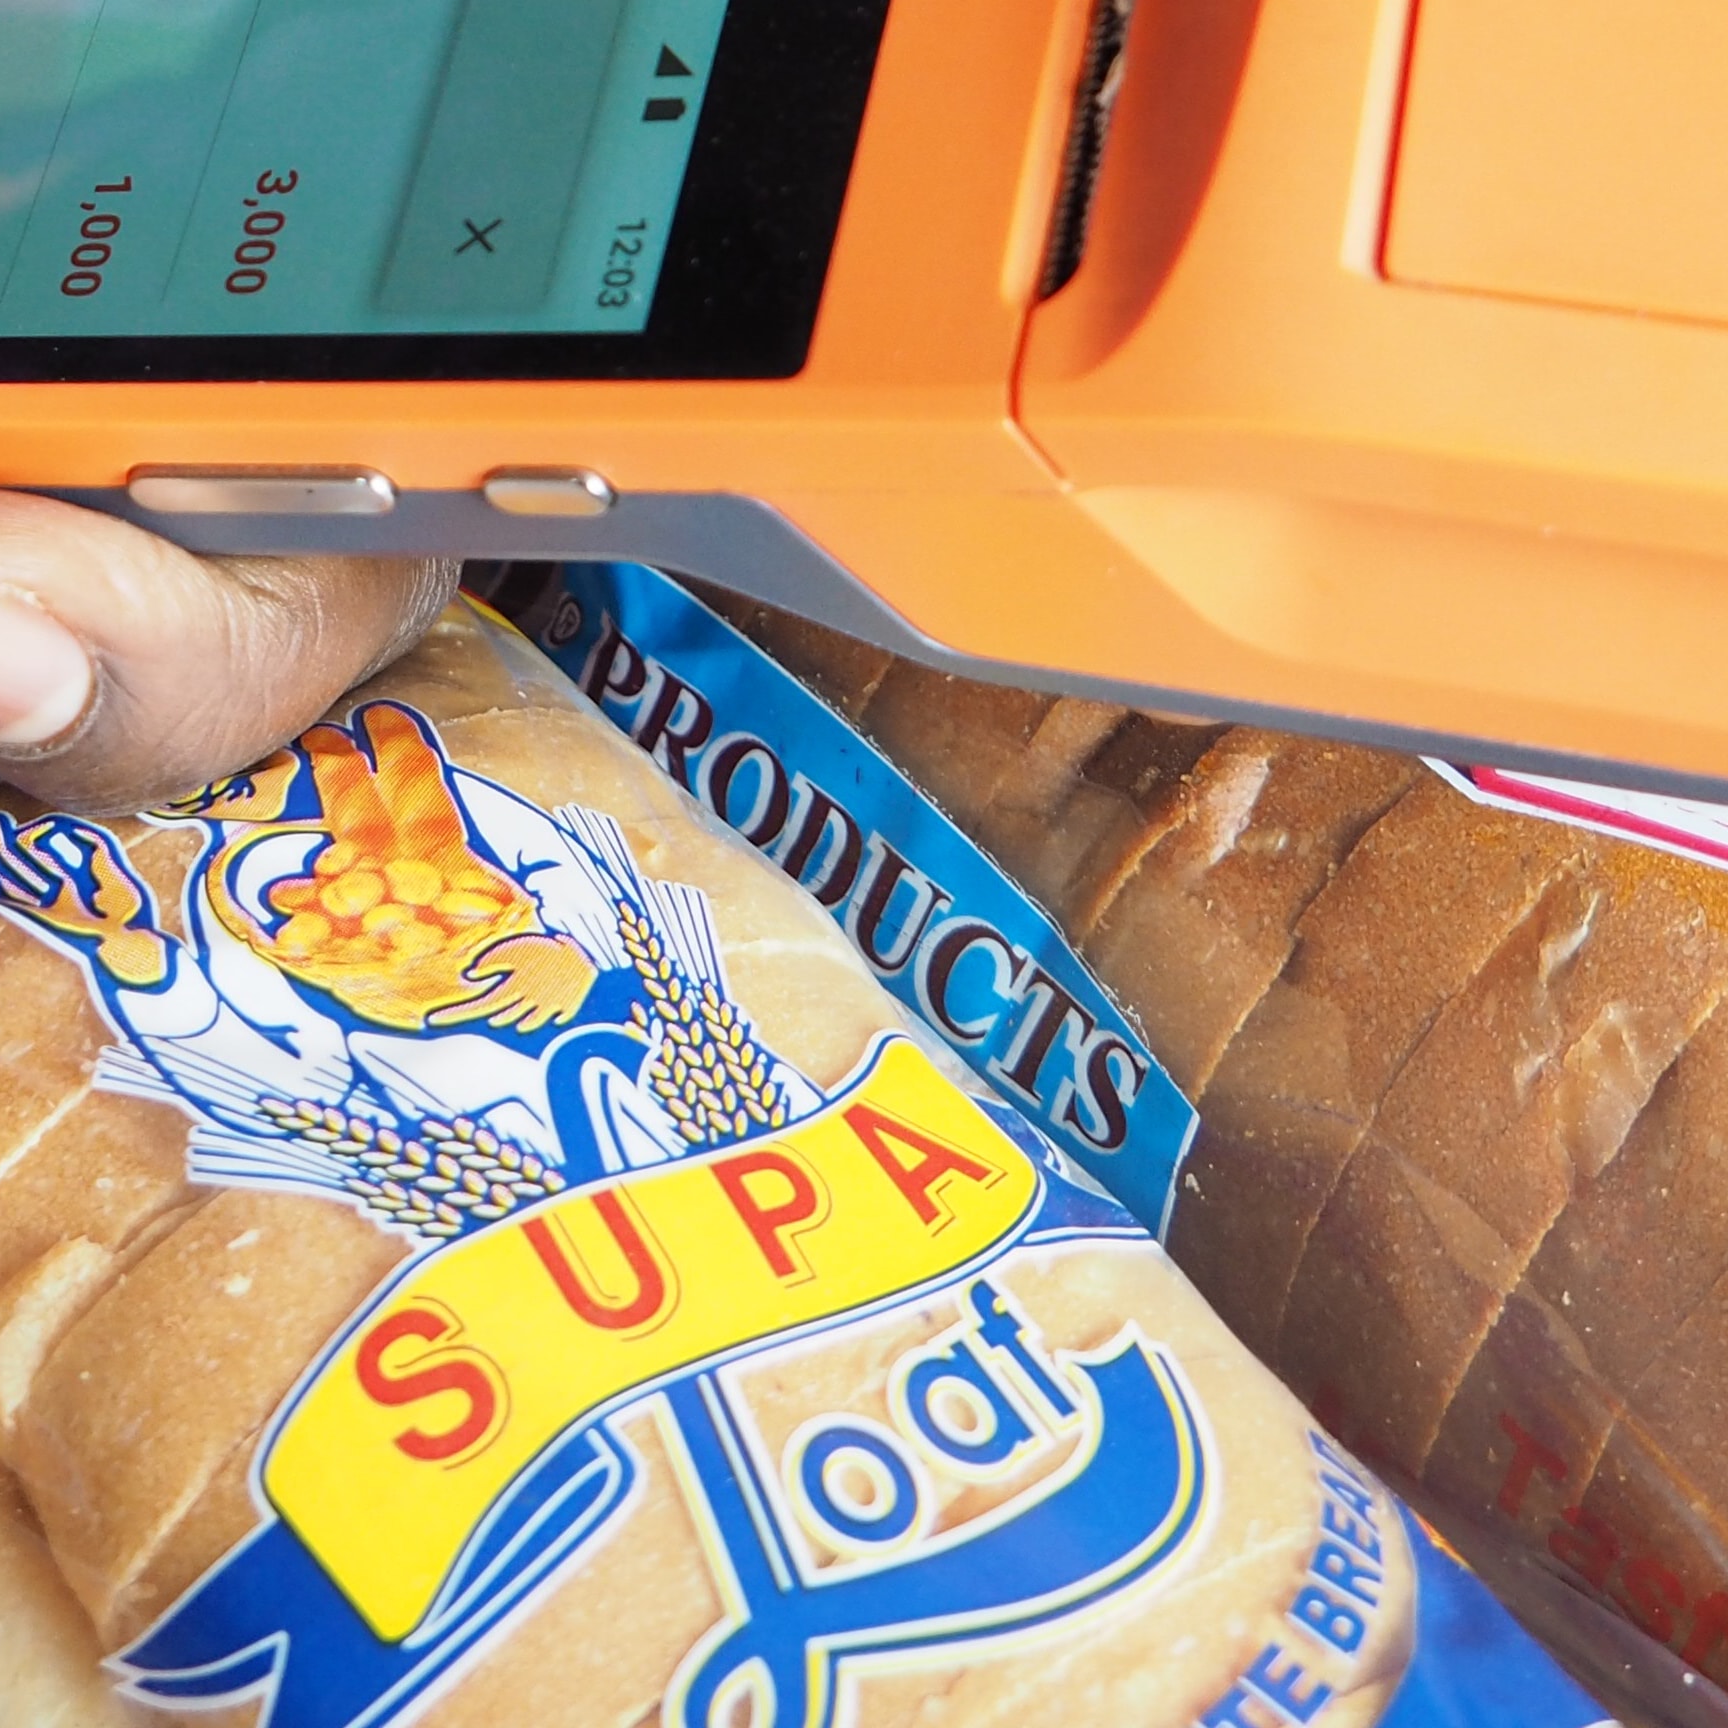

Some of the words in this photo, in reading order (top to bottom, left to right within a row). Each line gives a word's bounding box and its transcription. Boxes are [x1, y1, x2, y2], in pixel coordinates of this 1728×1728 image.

[59, 175, 133, 298] 1,000
[224, 168, 298, 295] 3,000
[596, 217, 649, 310] 12:03
[581, 612, 1146, 1154] PRODUCTS
[352, 1100, 1008, 1472] SUPA
[666, 1276, 1222, 1728] Loaf
